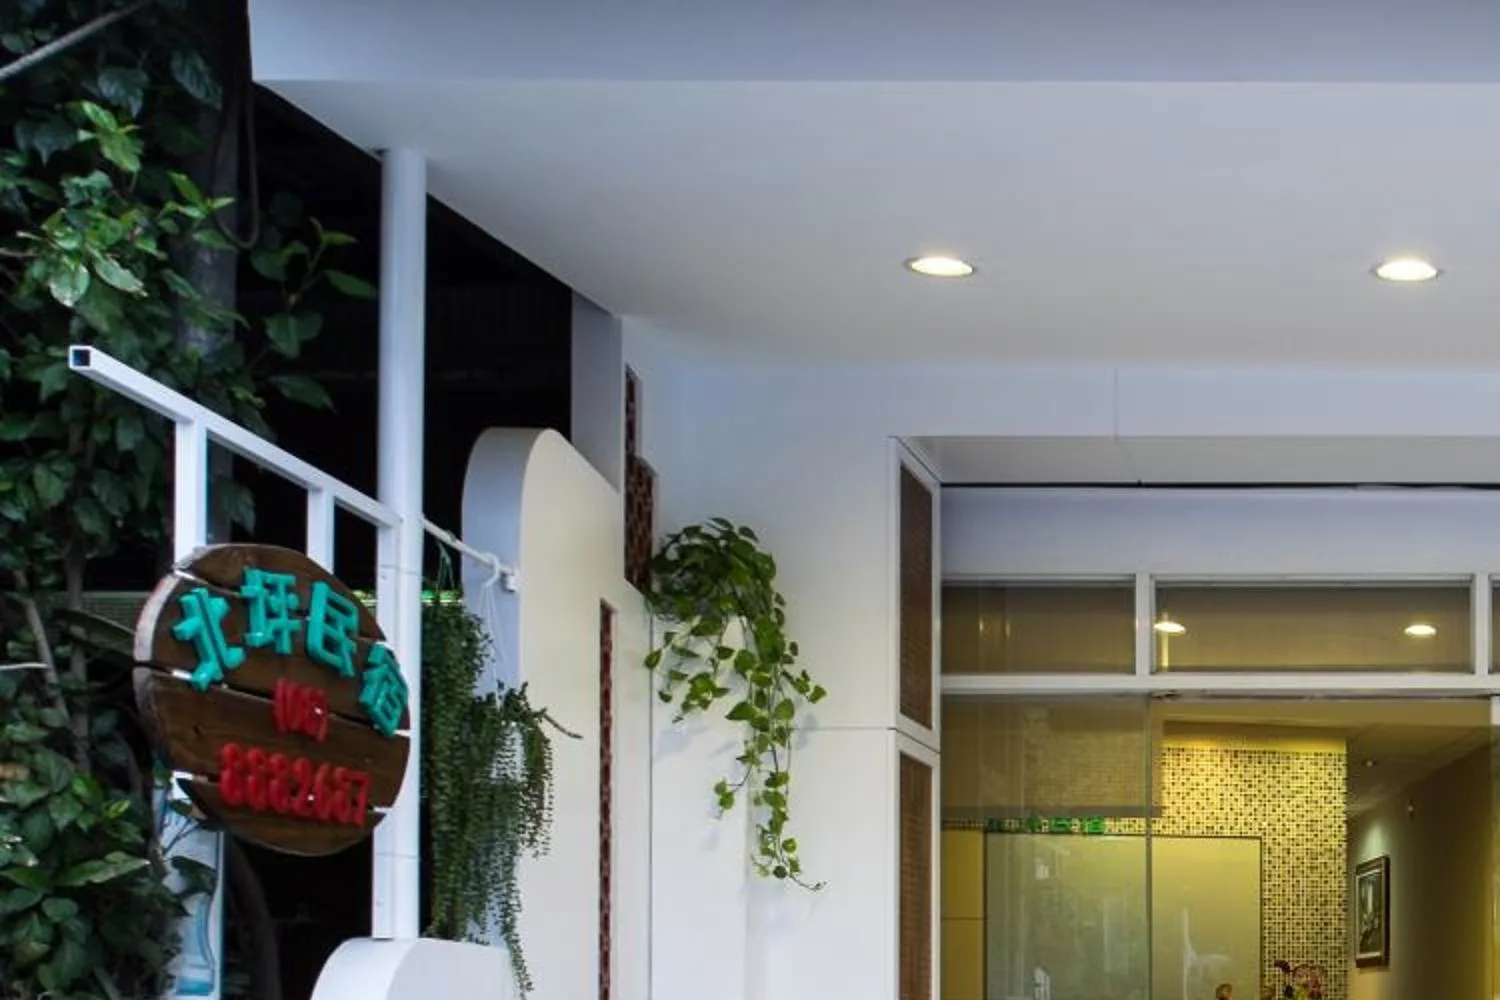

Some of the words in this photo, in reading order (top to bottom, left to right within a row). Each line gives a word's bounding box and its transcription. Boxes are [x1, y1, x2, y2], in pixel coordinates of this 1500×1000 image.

[172, 566, 410, 737] 北坪民宿
[218, 742, 372, 828] 8882687
